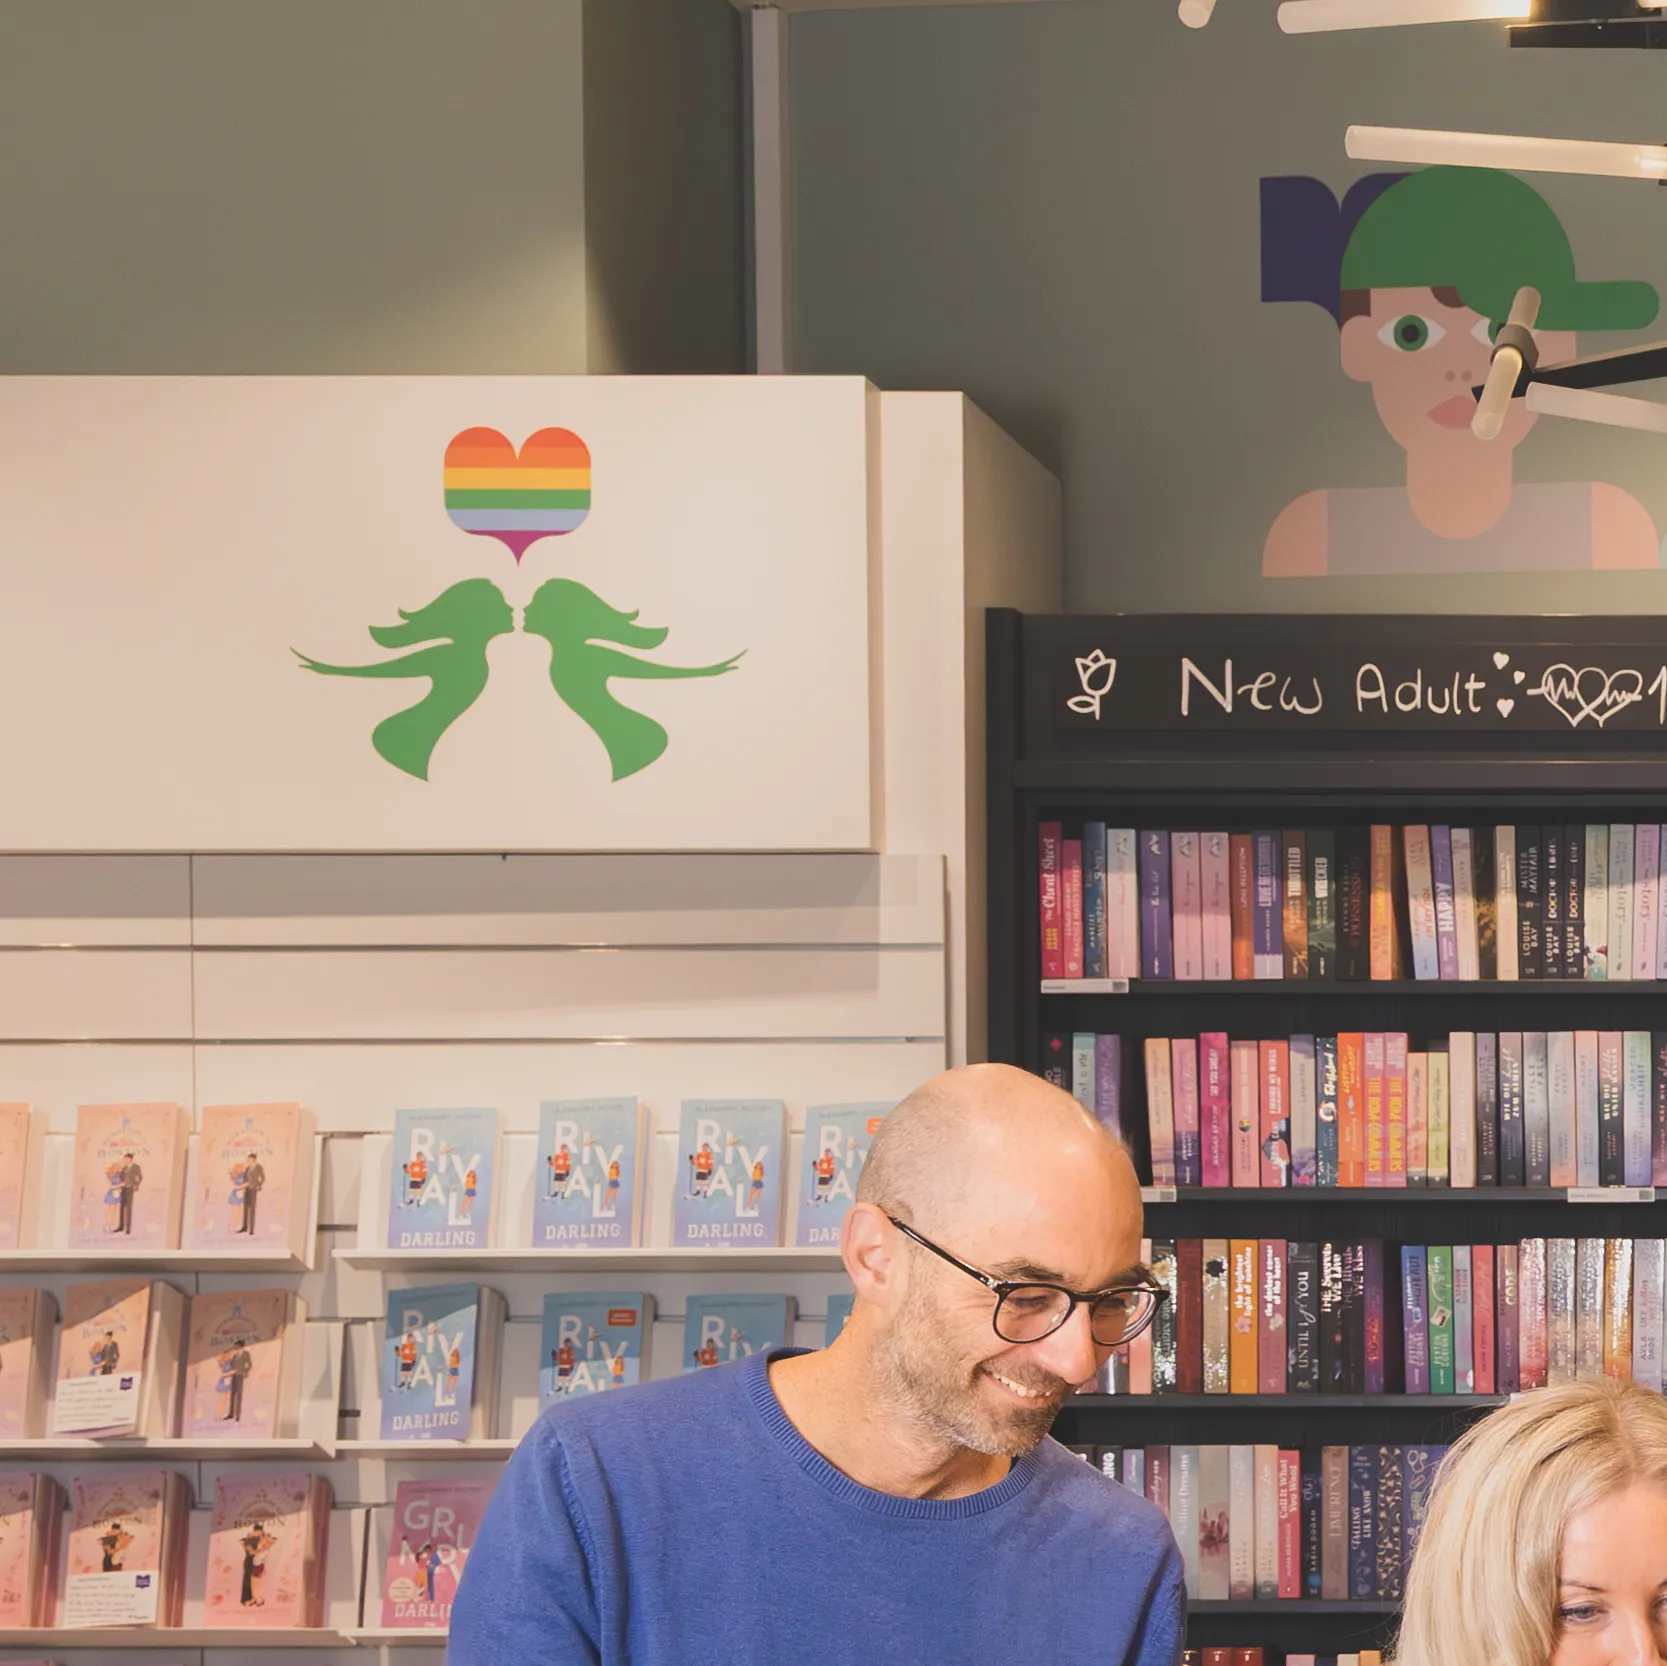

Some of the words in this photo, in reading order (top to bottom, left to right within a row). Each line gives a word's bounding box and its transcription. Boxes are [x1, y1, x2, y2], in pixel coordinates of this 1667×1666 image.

[1181, 658, 1322, 716] New
[1357, 664, 1485, 714] Adult
[1041, 838, 1056, 871] Sheet
[1529, 845, 1538, 893] MAYFAIR
[1041, 873, 1056, 908] Cheat
[1436, 882, 1454, 932] HAPPY
[400, 1231, 476, 1248] DARLING
[545, 1224, 621, 1240] DARLING
[687, 1223, 764, 1238] DARLING
[392, 1411, 459, 1431] DARLING
